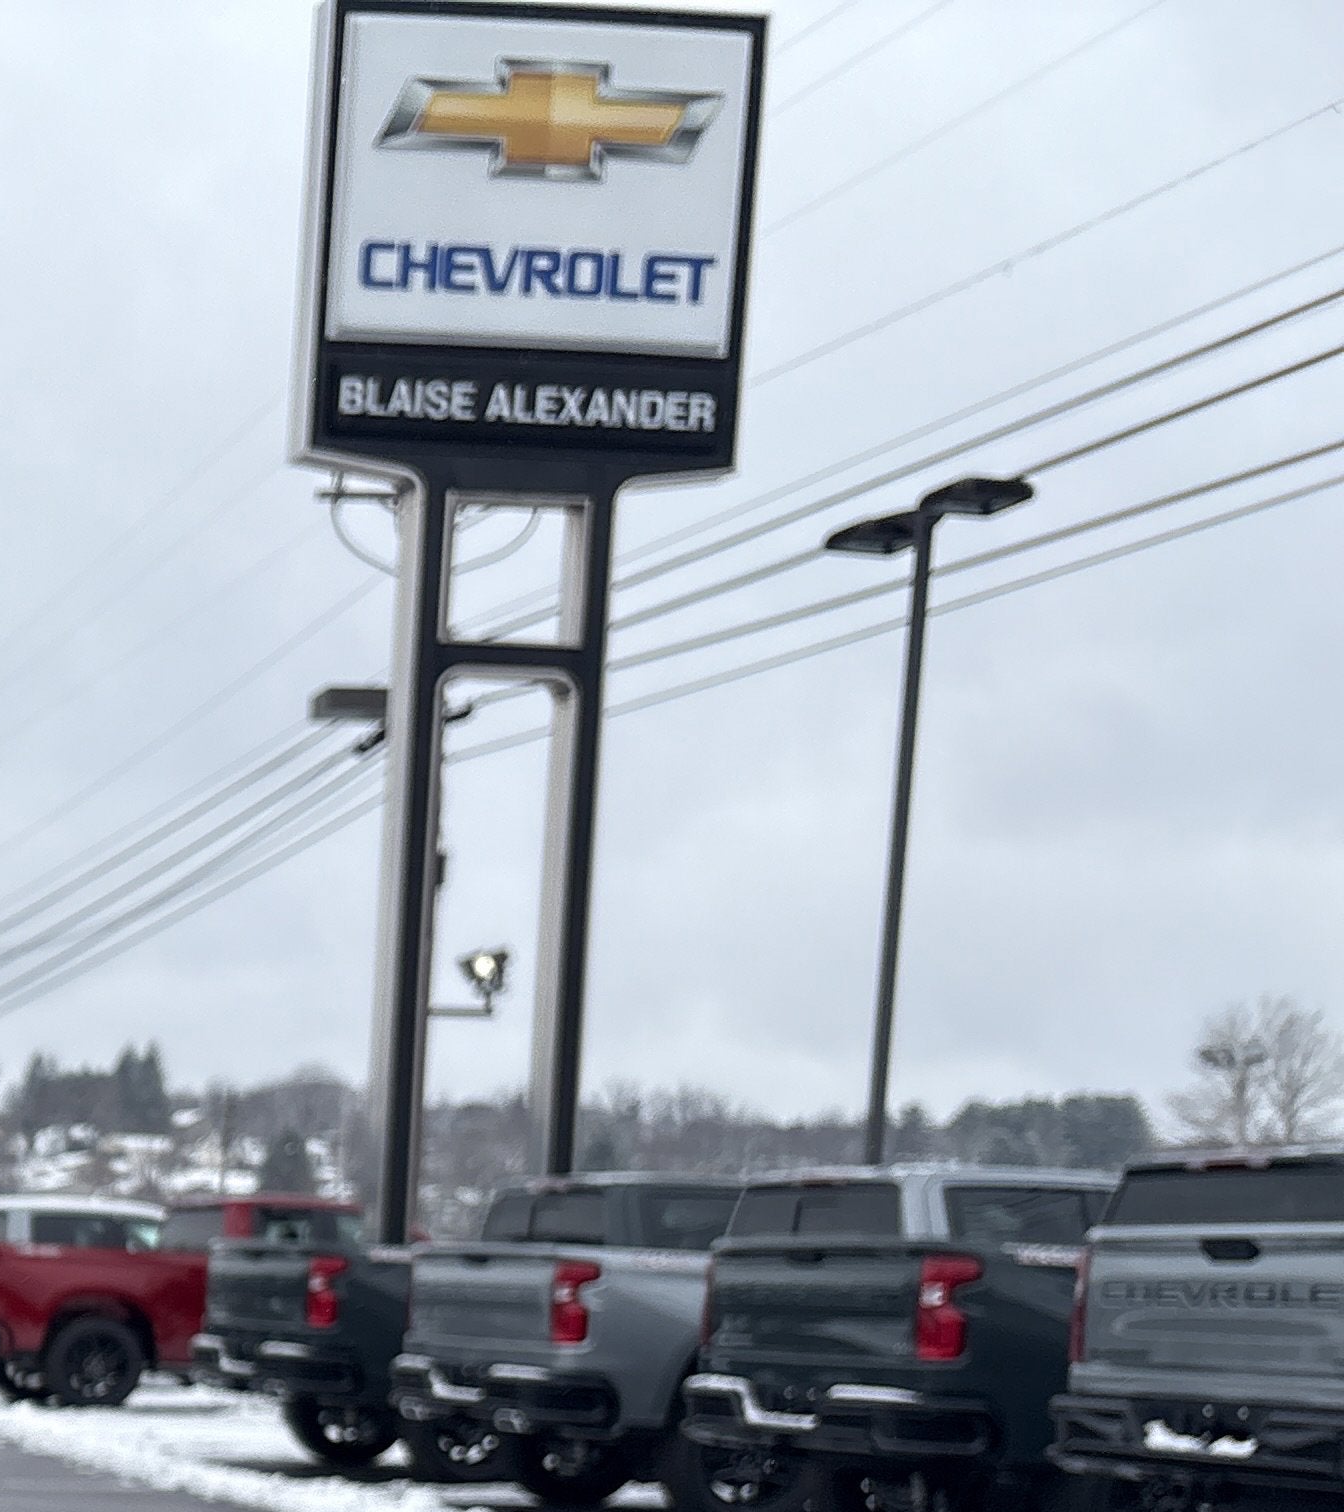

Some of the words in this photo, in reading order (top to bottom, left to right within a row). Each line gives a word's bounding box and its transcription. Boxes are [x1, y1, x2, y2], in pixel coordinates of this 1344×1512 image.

[360, 240, 718, 305] CHEVROLET
[338, 374, 478, 422] BLAISE
[485, 379, 717, 433] ALEXANDER
